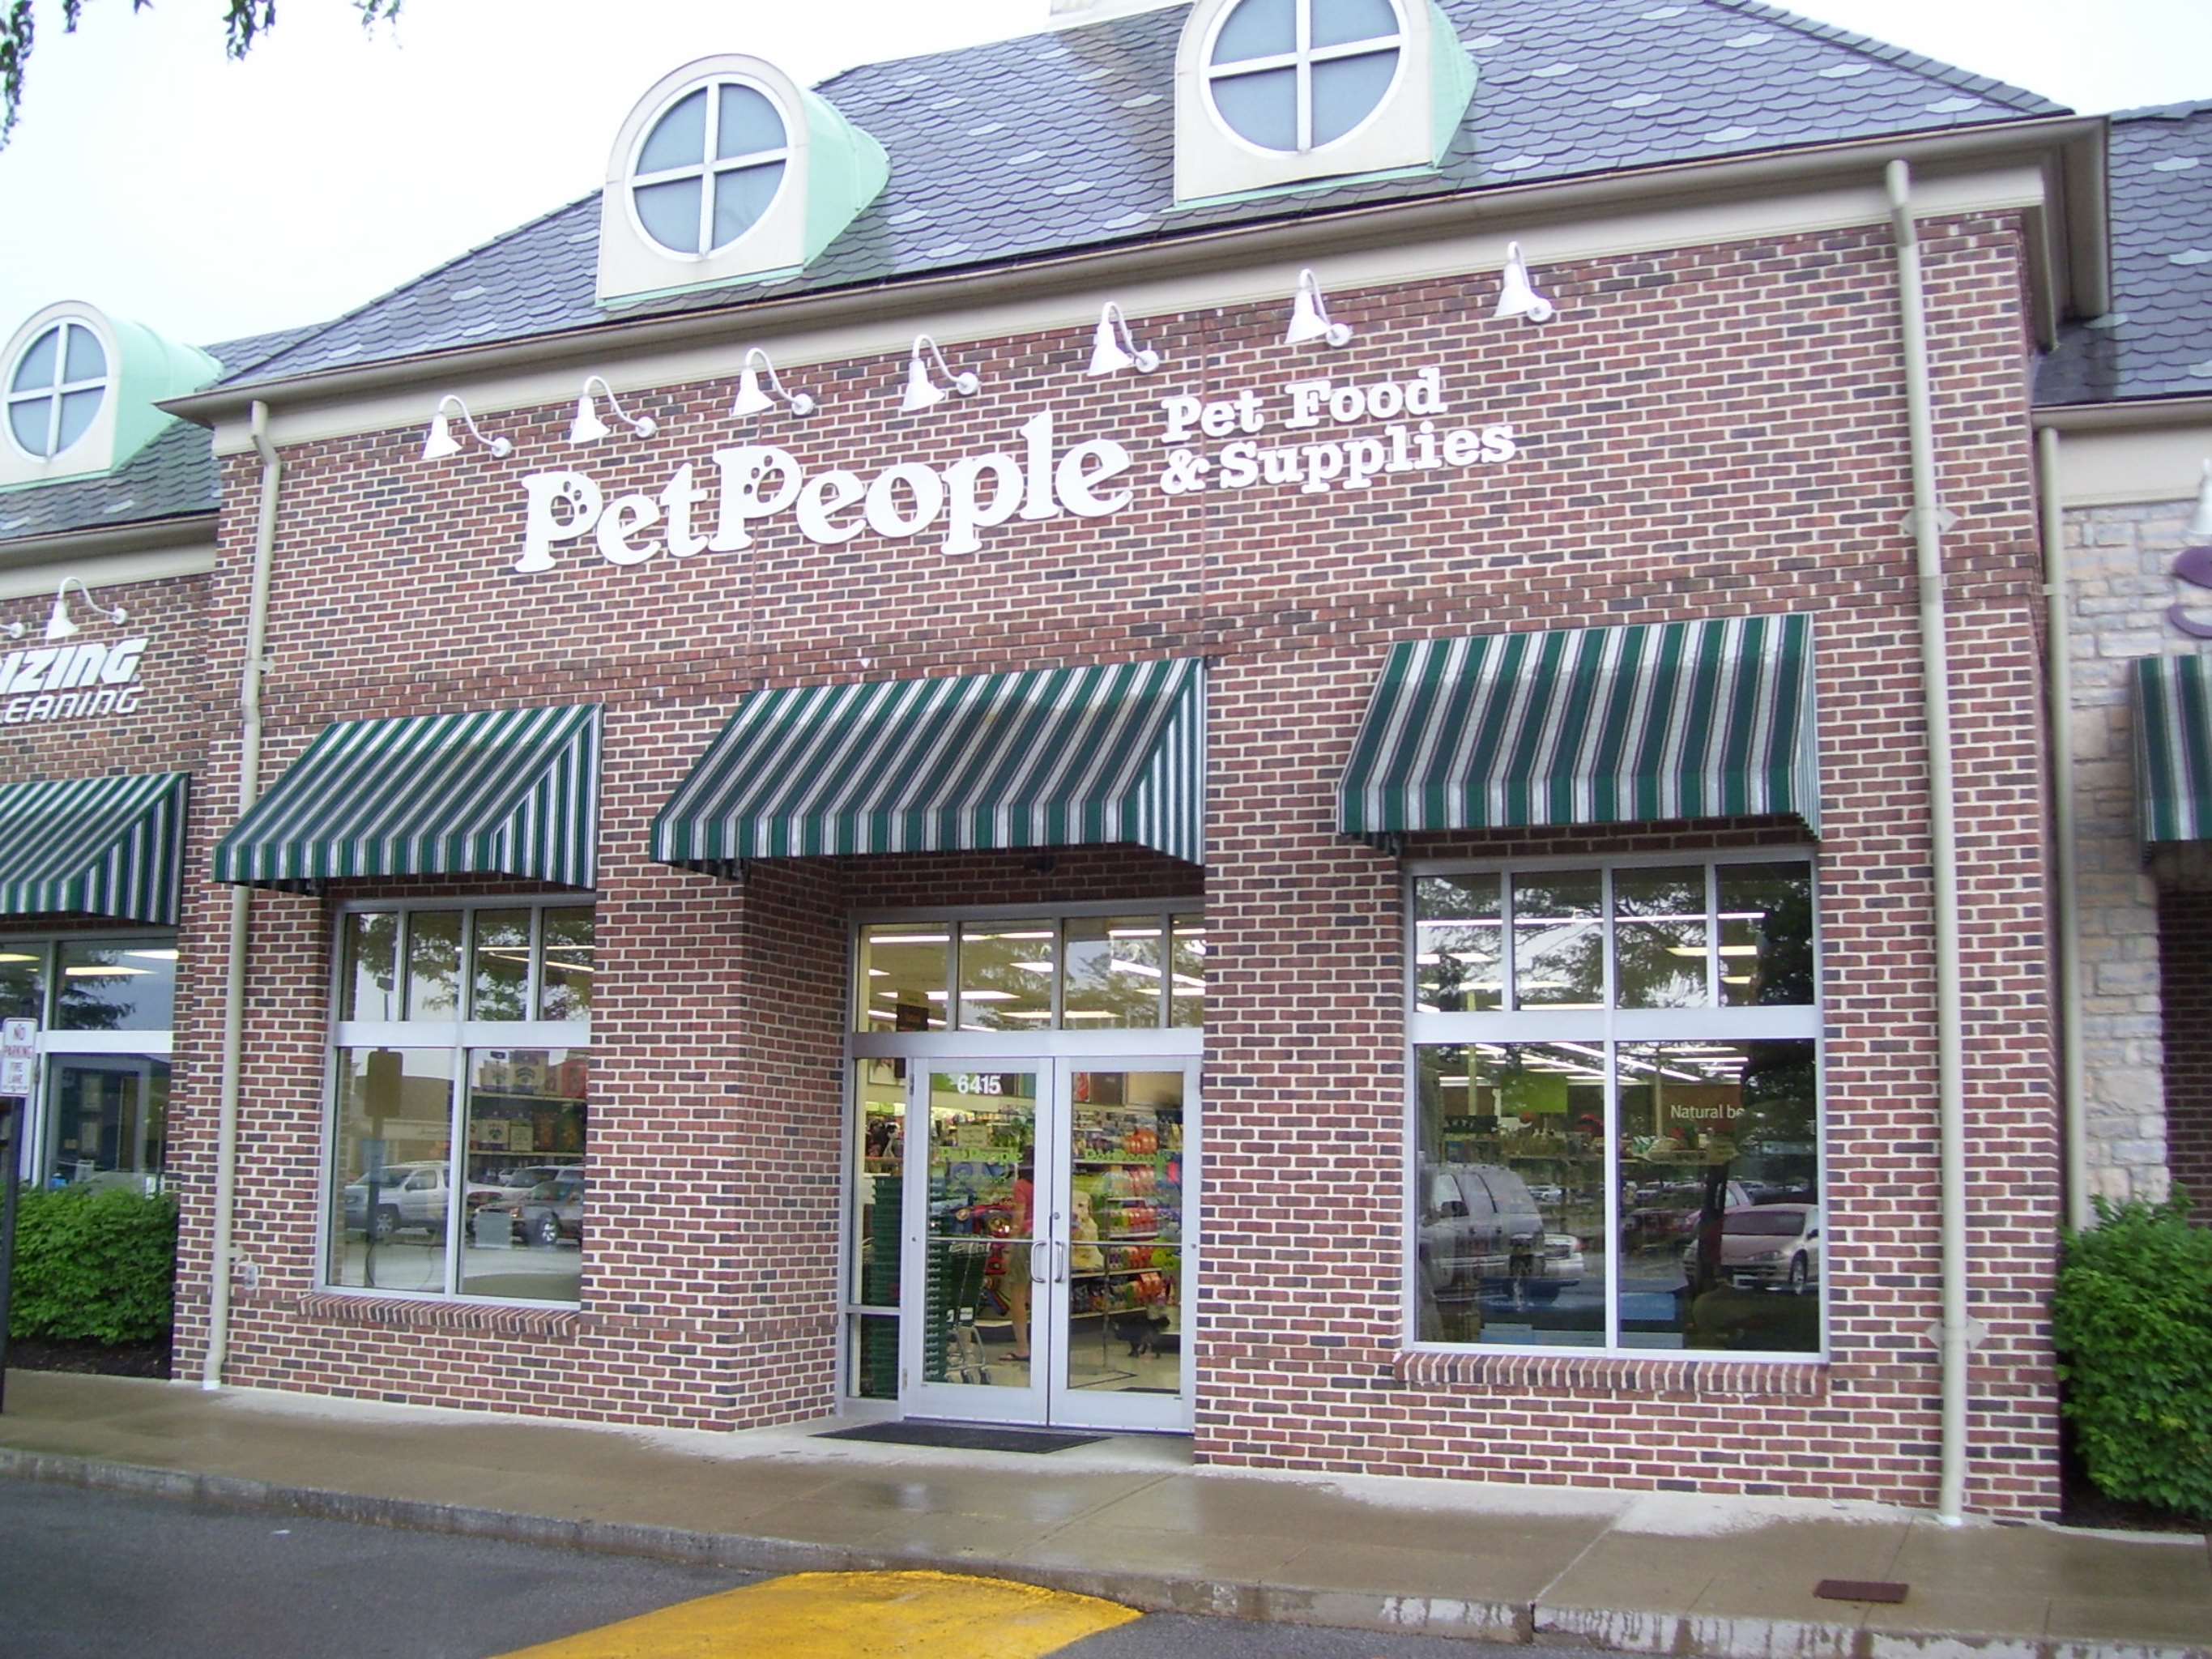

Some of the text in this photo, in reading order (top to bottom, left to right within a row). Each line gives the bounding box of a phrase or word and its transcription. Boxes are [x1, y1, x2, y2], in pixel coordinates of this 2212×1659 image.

[1161, 367, 1448, 444] Pet Food
[1159, 420, 1517, 495] & Supplies
[514, 410, 1133, 574] PetPeople
[0, 638, 149, 695] IZING
[957, 1075, 1002, 1094] 6415
[1670, 1104, 1723, 1120] Natural
[940, 1147, 1024, 1164] PPeople
